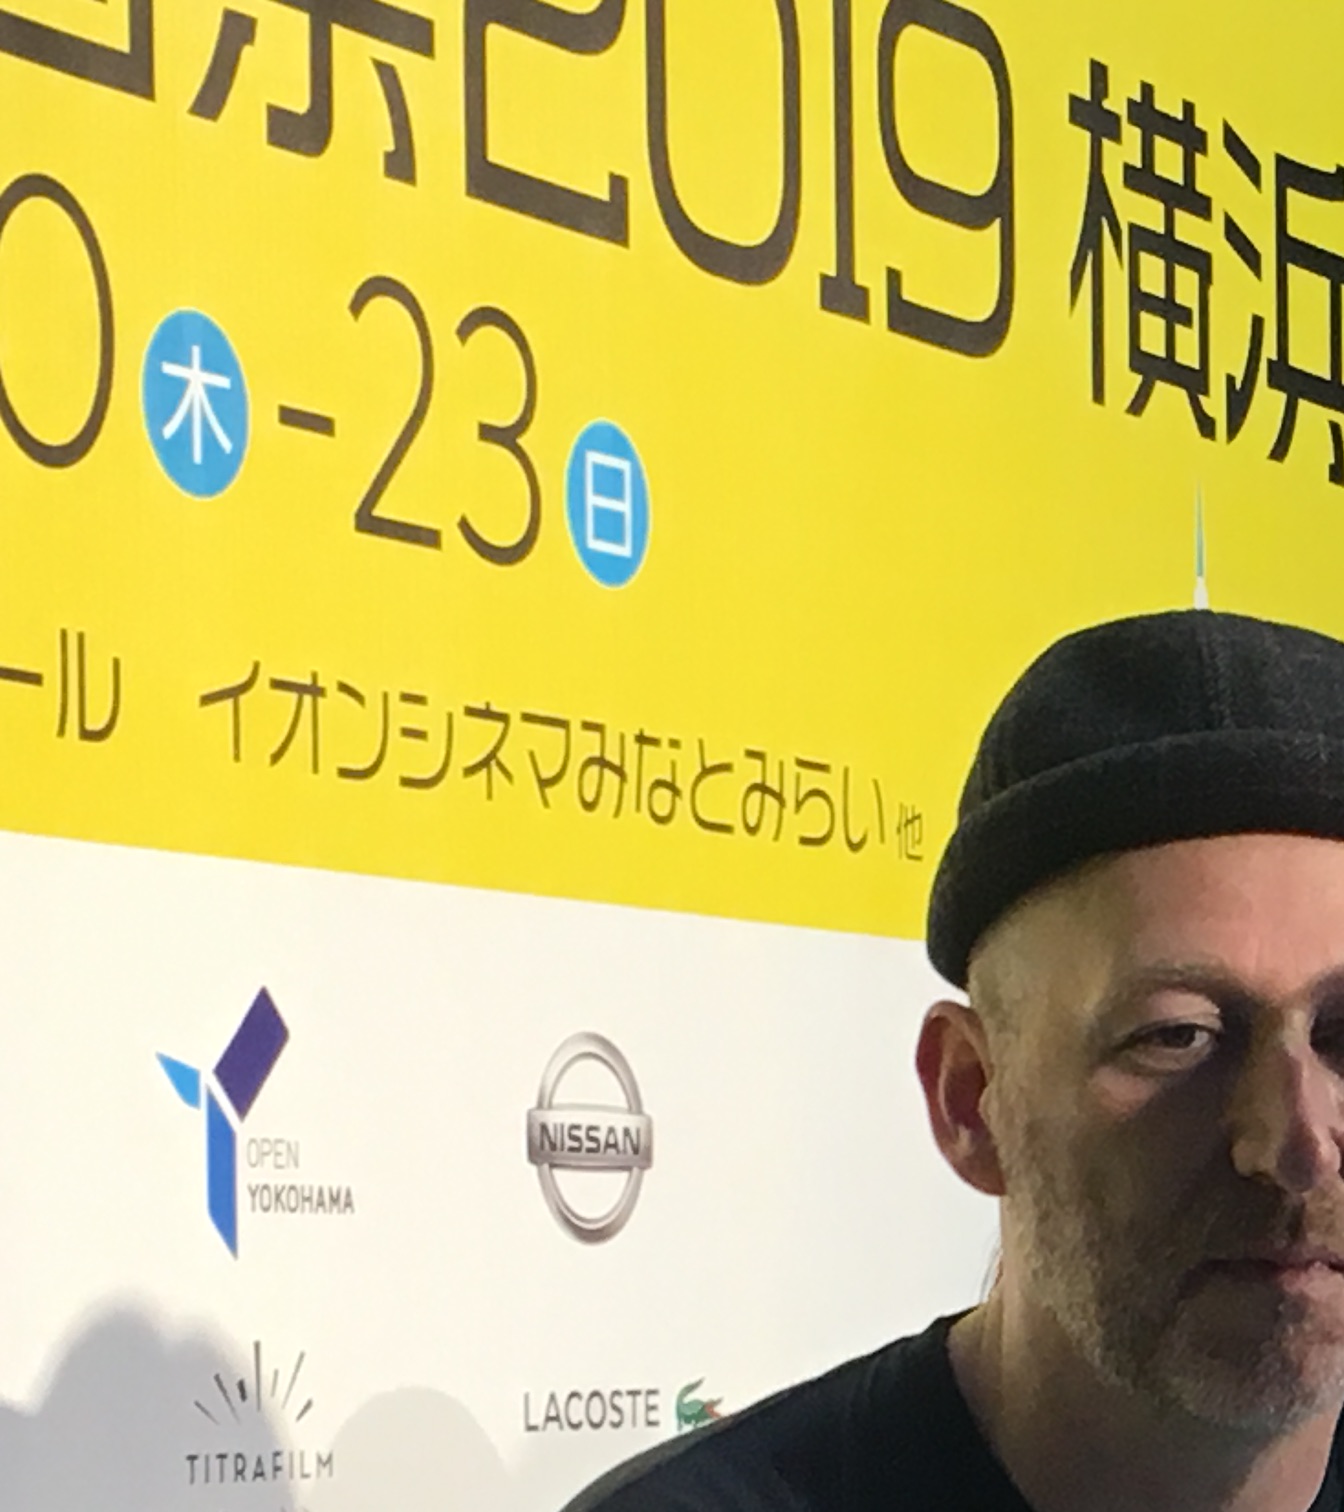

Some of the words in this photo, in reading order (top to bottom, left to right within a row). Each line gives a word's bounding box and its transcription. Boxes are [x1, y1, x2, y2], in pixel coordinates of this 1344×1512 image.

[246, 1138, 300, 1170] OPEN
[538, 1121, 642, 1157] NISSAN
[246, 1183, 355, 1215] YOKOHAMA
[523, 1388, 661, 1433] LACOSTE
[185, 1451, 334, 1485] TITRAFILM
